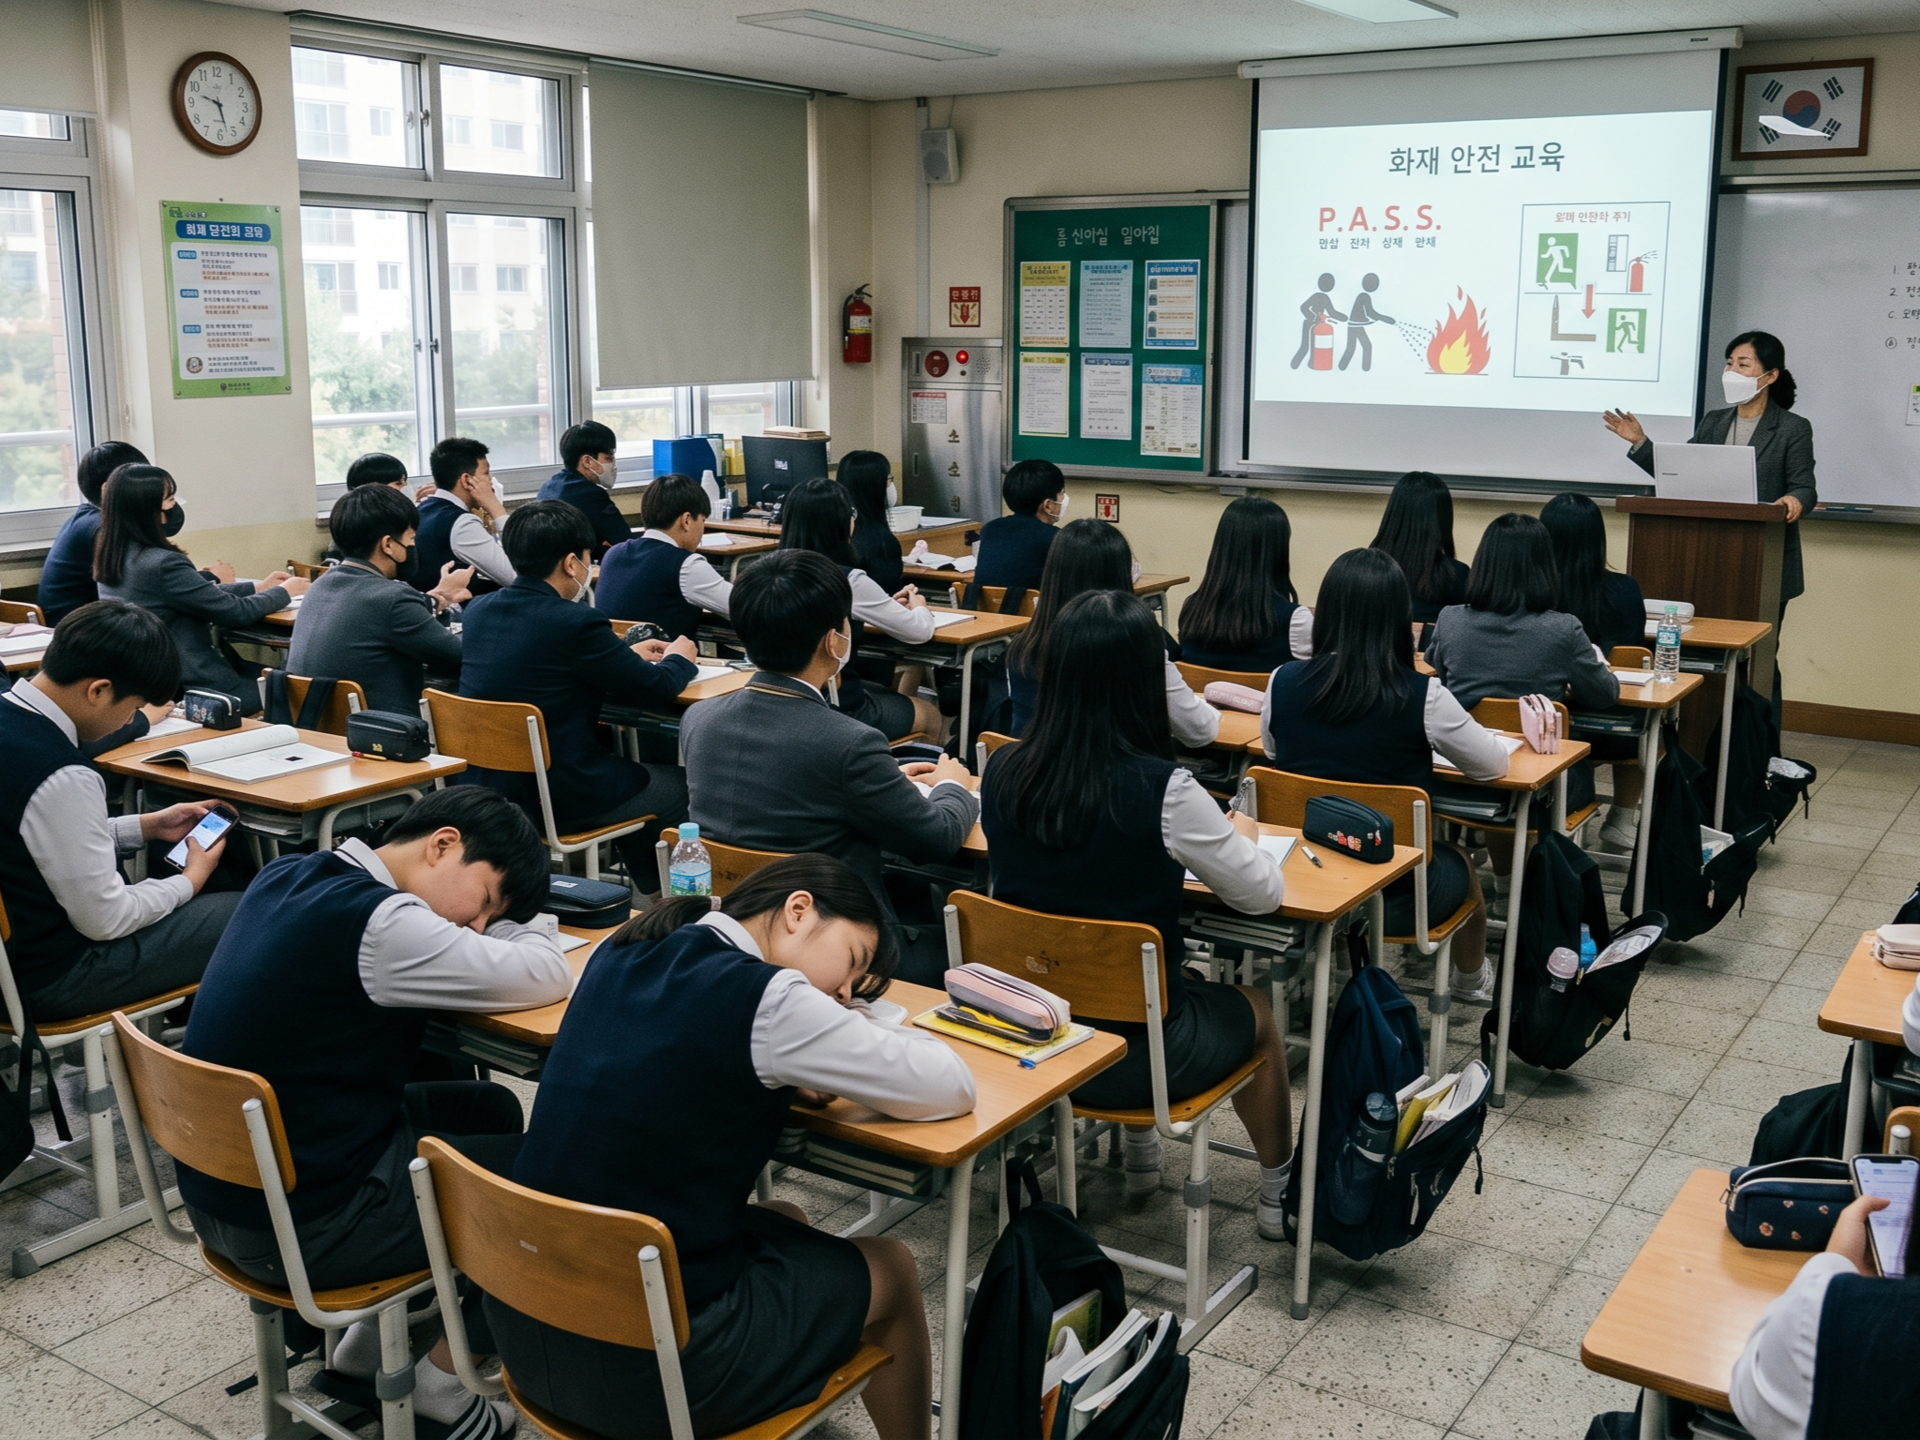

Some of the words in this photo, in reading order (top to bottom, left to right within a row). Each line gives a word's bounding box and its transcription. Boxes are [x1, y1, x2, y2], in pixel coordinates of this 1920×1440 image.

[198, 69, 207, 81] 11
[212, 66, 222, 78] 12
[229, 73, 233, 85] 1
[190, 81, 200, 92] 10
[238, 87, 244, 98] 2
[188, 97, 195, 108] 9
[242, 102, 248, 113] 3
[193, 113, 200, 124] 8
[239, 116, 245, 126] 4
[203, 125, 209, 136] 7
[217, 129, 223, 141] 6
[1389, 146, 1439, 176] 화재
[1451, 143, 1501, 174] 안전
[1511, 142, 1565, 172] 교육
